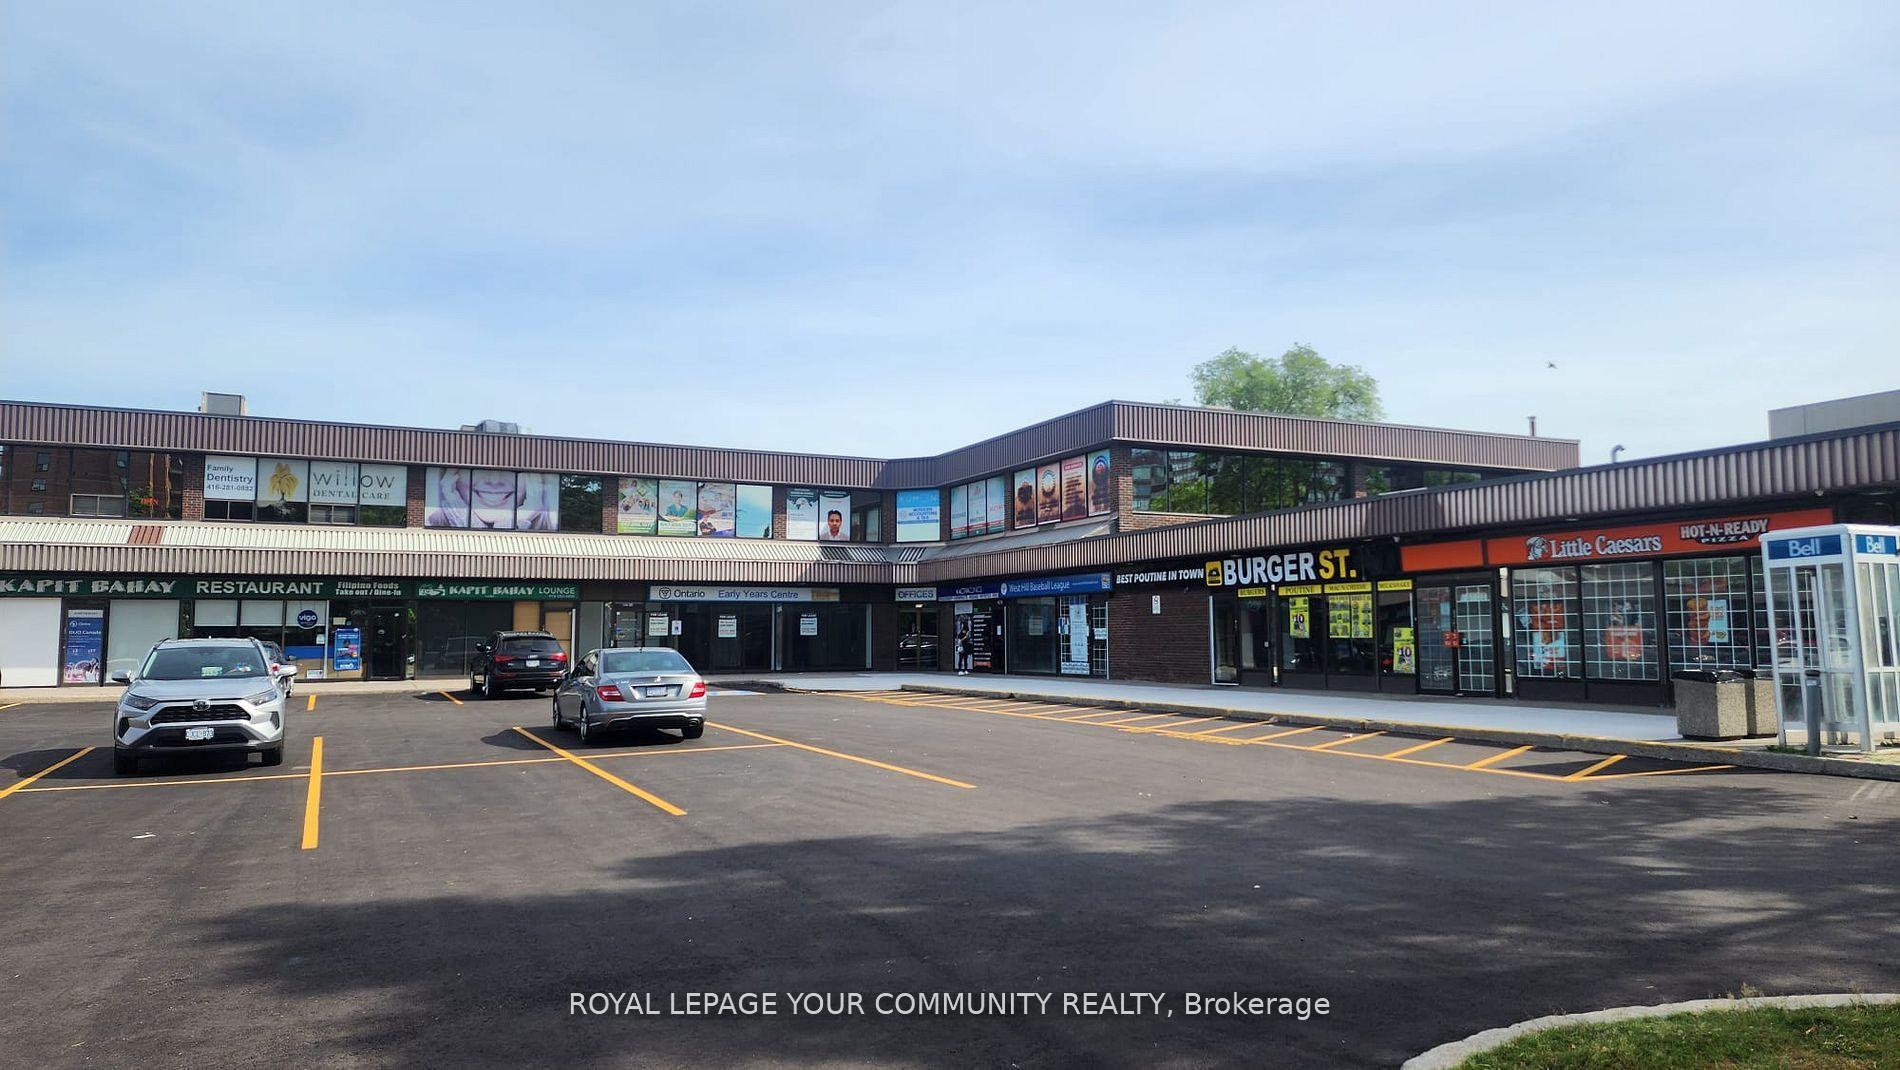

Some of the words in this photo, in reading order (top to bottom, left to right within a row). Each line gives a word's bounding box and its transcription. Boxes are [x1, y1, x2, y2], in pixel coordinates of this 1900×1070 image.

[206, 464, 234, 474] Family
[206, 473, 253, 484] Dentistry
[312, 489, 356, 500] DENTAL
[361, 491, 390, 501] CARE
[1679, 518, 1769, 540] HOT-N-READY
[1700, 534, 1749, 545] PIZZA
[1551, 540, 1592, 558] Little
[1595, 535, 1662, 557] Caesars
[1789, 538, 1821, 557] Bell
[1866, 538, 1886, 555] Bell
[1223, 552, 1317, 586] BURGER
[1319, 549, 1358, 579] ST.
[1116, 573, 1132, 584] BEST
[1134, 571, 1166, 584] POUTINE
[1168, 571, 1177, 581] IN
[1178, 569, 1204, 581] TOWN
[0, 578, 83, 594] KAPIT
[91, 579, 176, 595] BAHAY
[196, 581, 324, 595] RESTAURANT
[338, 581, 371, 591] Filipino
[373, 582, 400, 591] Foods
[449, 586, 487, 595] KAPIT
[493, 587, 534, 596] BAHAY
[539, 586, 576, 596] LOUNGE
[1009, 583, 1021, 592] West
[1022, 582, 1031, 591] Hill
[1030, 579, 1050, 591] Baseball
[1051, 580, 1069, 591] League
[336, 588, 353, 598] Take
[356, 589, 369, 598] out
[370, 588, 374, 597] /
[374, 589, 402, 598] Dine-in
[674, 588, 706, 600] Ontario
[718, 589, 742, 601] Early
[744, 589, 769, 601] Years
[771, 590, 800, 600] Centre
[898, 590, 934, 601] OFFICES
[299, 615, 317, 623] vigo
